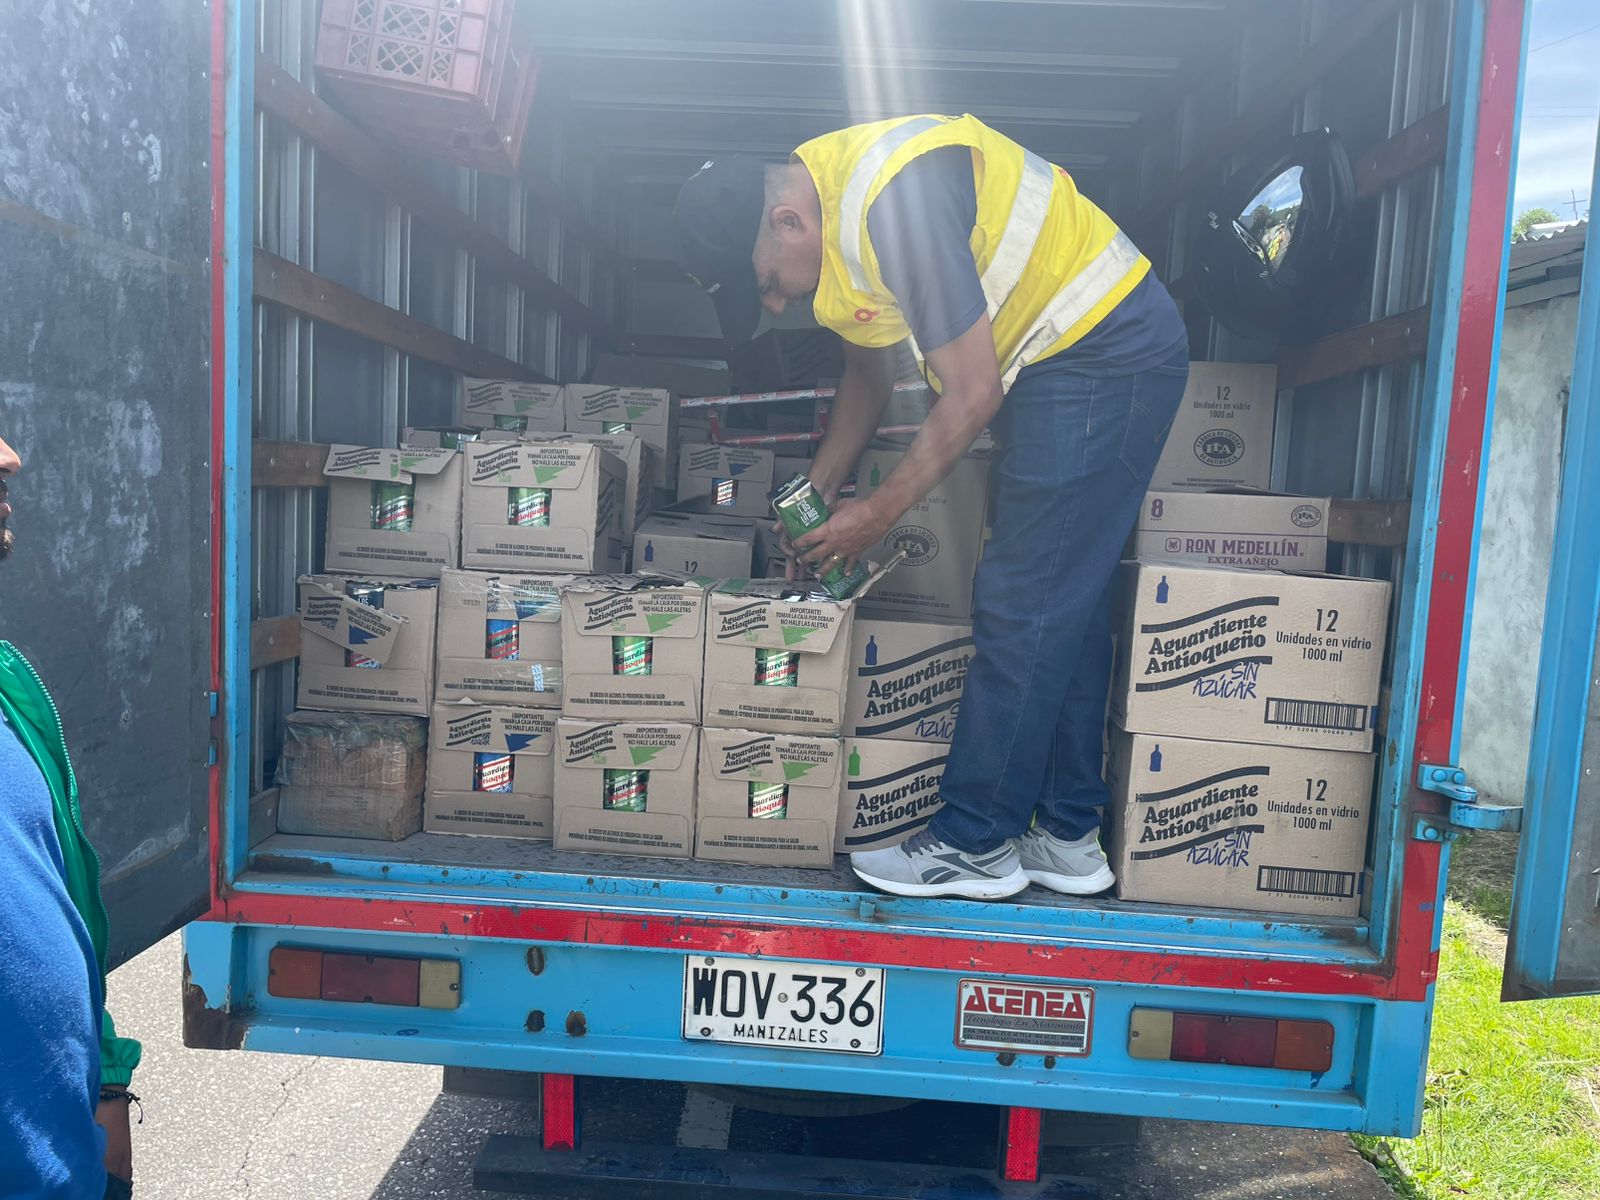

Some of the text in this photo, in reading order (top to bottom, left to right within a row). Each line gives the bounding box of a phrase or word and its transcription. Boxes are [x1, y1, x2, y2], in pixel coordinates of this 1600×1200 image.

[1217, 386, 1231, 401] 12
[475, 457, 518, 475] Antioqueño
[477, 451, 518, 468] Aguardiente
[1152, 499, 1163, 517] 8
[1186, 538, 1299, 557] RON MEDELLÍN
[1208, 556, 1279, 566] EXTRA AÑEJO
[588, 604, 633, 623] Antioqueño
[589, 596, 633, 615] Aguardiente
[721, 615, 766, 632] Antioqueño
[722, 607, 766, 624] Aguardiente
[1316, 609, 1338, 632] 12
[1149, 614, 1267, 656] Aguardiente
[1276, 631, 1372, 649] Unidades en vidrio
[1144, 630, 1267, 675] Antioqueño
[1302, 648, 1342, 662] 1000 ml
[1231, 662, 1260, 681] SIN
[1193, 673, 1256, 698] AZÚCAR
[448, 724, 491, 739] Antioqueño
[449, 717, 491, 732] Aguardiente
[569, 738, 613, 756] Antioqueño
[570, 730, 613, 748] Aguardiente
[724, 751, 770, 767] Antioqueño
[726, 743, 770, 760] Aguardiente
[1306, 778, 1328, 801] 12
[1143, 783, 1259, 825] Aguardiente
[1267, 800, 1360, 819] Unidades en vidrio
[1140, 799, 1258, 843] Antioqueño
[1293, 816, 1332, 831] 1000 ml
[1224, 830, 1254, 849] SIN
[1186, 842, 1249, 867] AZÚCAR
[693, 968, 876, 1028] WOV 336
[963, 986, 1087, 1019] ATENEA
[733, 1023, 828, 1044] MANIZALES
